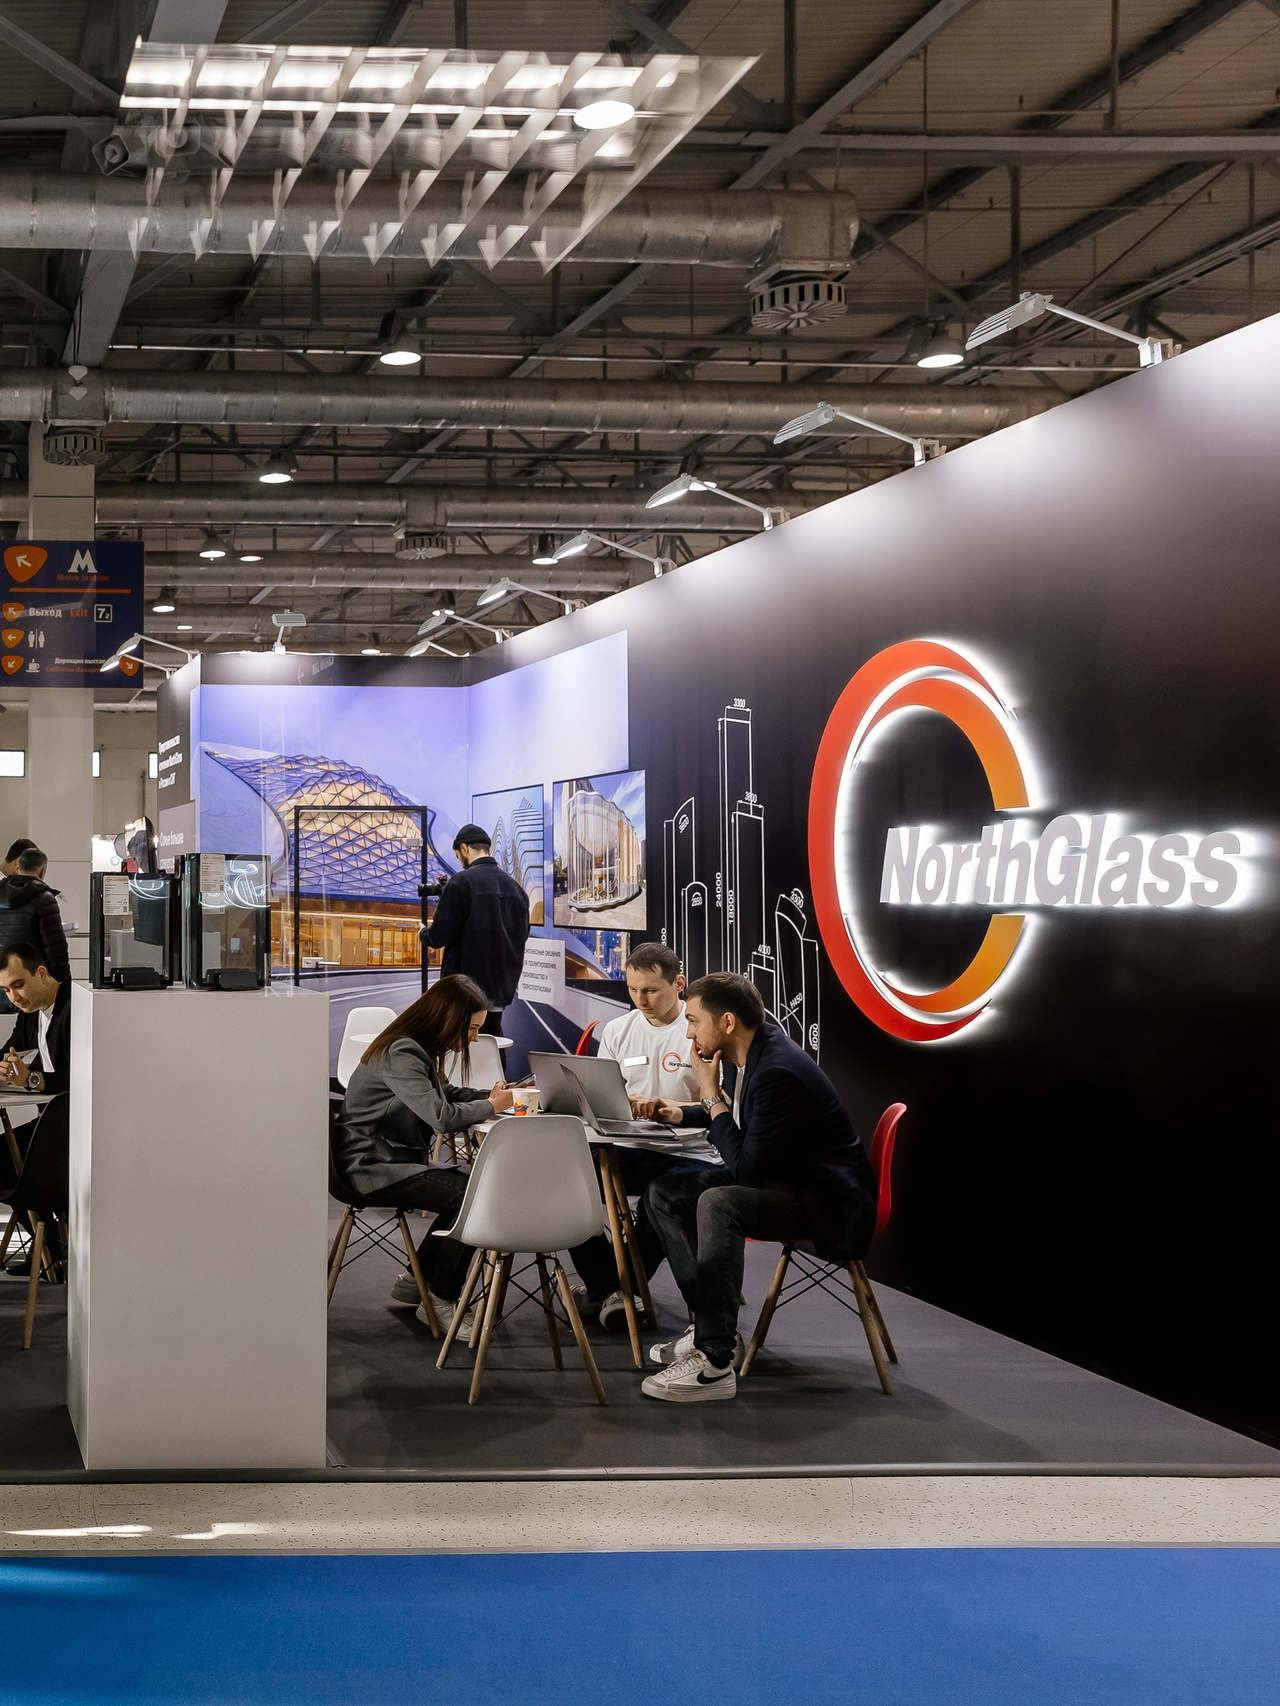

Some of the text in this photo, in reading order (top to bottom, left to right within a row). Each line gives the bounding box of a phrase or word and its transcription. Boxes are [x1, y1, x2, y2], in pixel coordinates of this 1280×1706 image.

[81, 574, 110, 582] Station
[28, 607, 63, 618] Выход
[69, 608, 88, 617] Exit
[880, 813, 1241, 908] NorthGlass
[668, 1061, 693, 1069] NorthGlas
